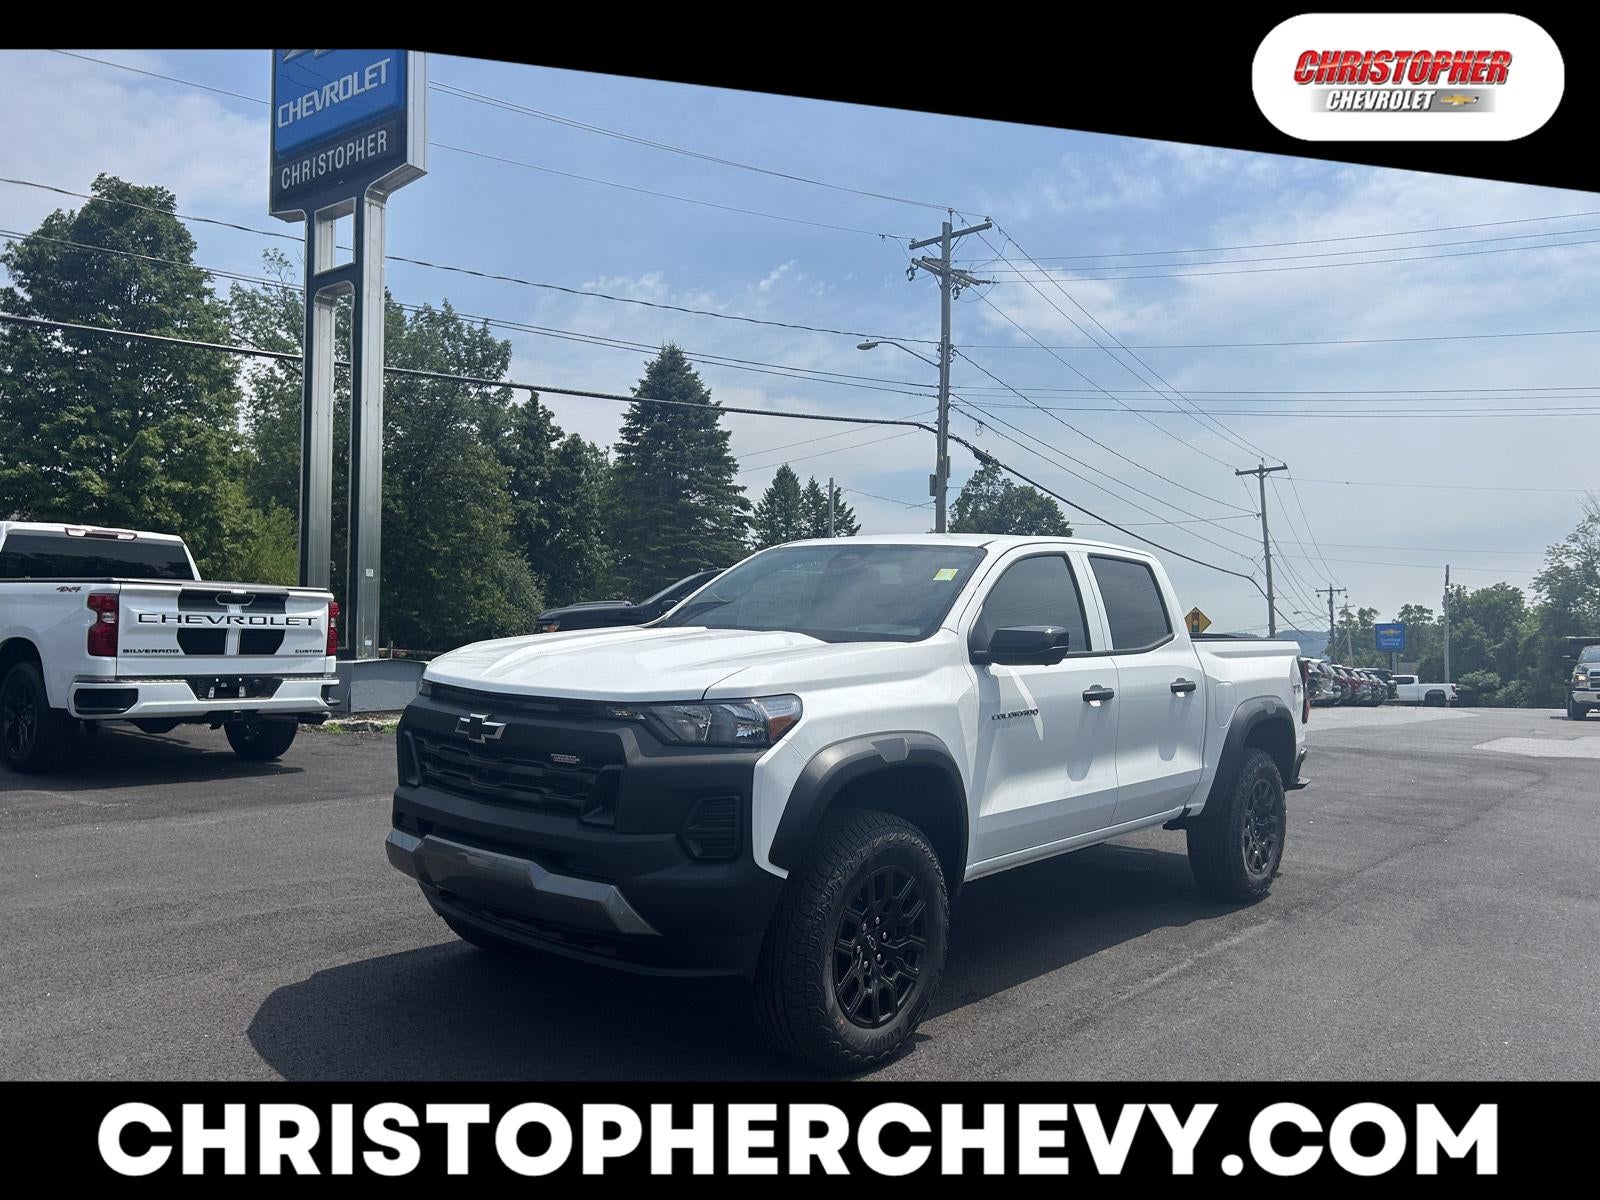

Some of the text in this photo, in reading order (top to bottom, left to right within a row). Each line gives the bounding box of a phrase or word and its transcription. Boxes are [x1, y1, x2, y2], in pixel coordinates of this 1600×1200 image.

[278, 58, 391, 128] CHEVROLET
[281, 130, 387, 189] CHRISTOPHER
[137, 613, 318, 627] CHEVROLET
